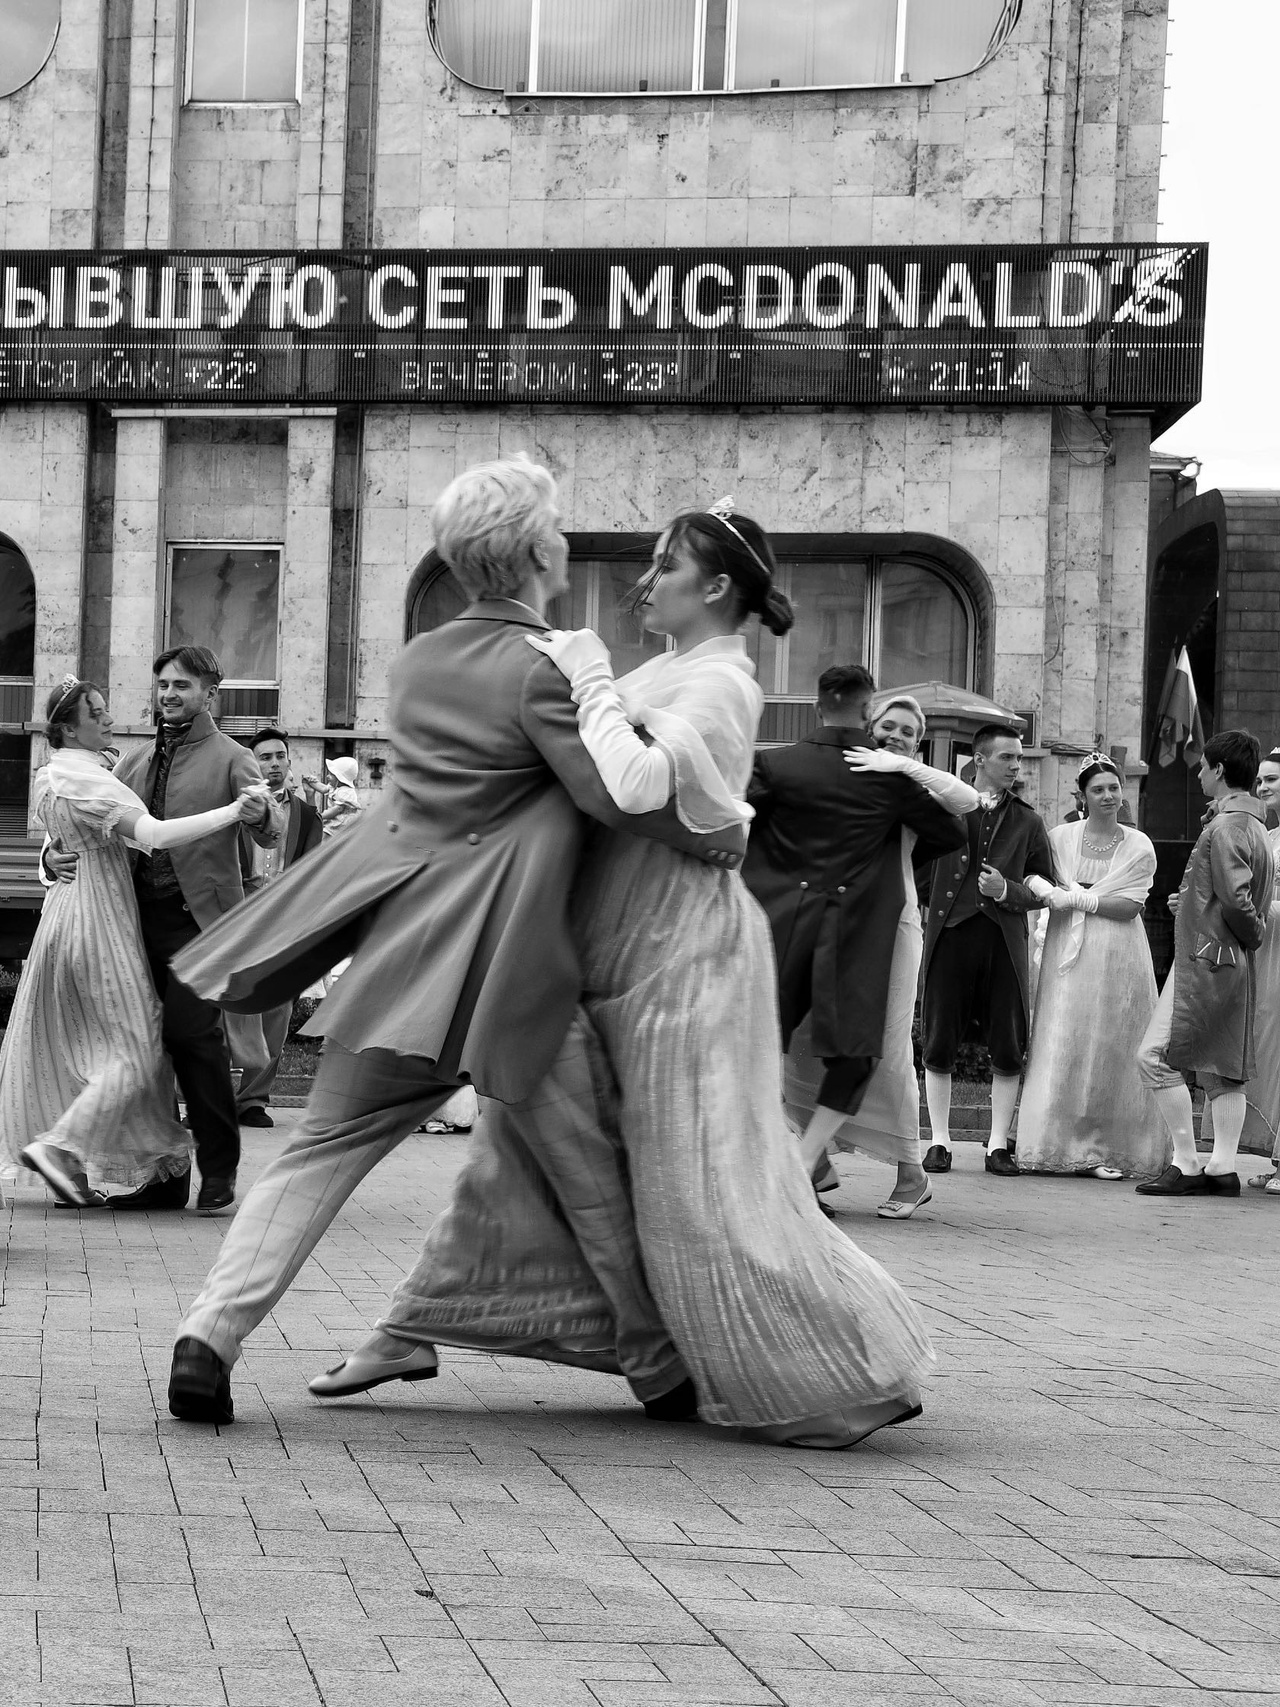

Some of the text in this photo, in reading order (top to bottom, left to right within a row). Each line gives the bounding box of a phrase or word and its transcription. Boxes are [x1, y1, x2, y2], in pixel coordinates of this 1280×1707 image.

[368, 263, 578, 330] СЕТЬ
[608, 260, 1184, 330] MCDONALD'S
[184, 359, 258, 390] +22°
[400, 361, 679, 392] ВЕЧЕРОМ: +23°
[929, 361, 1031, 392] 21:14
